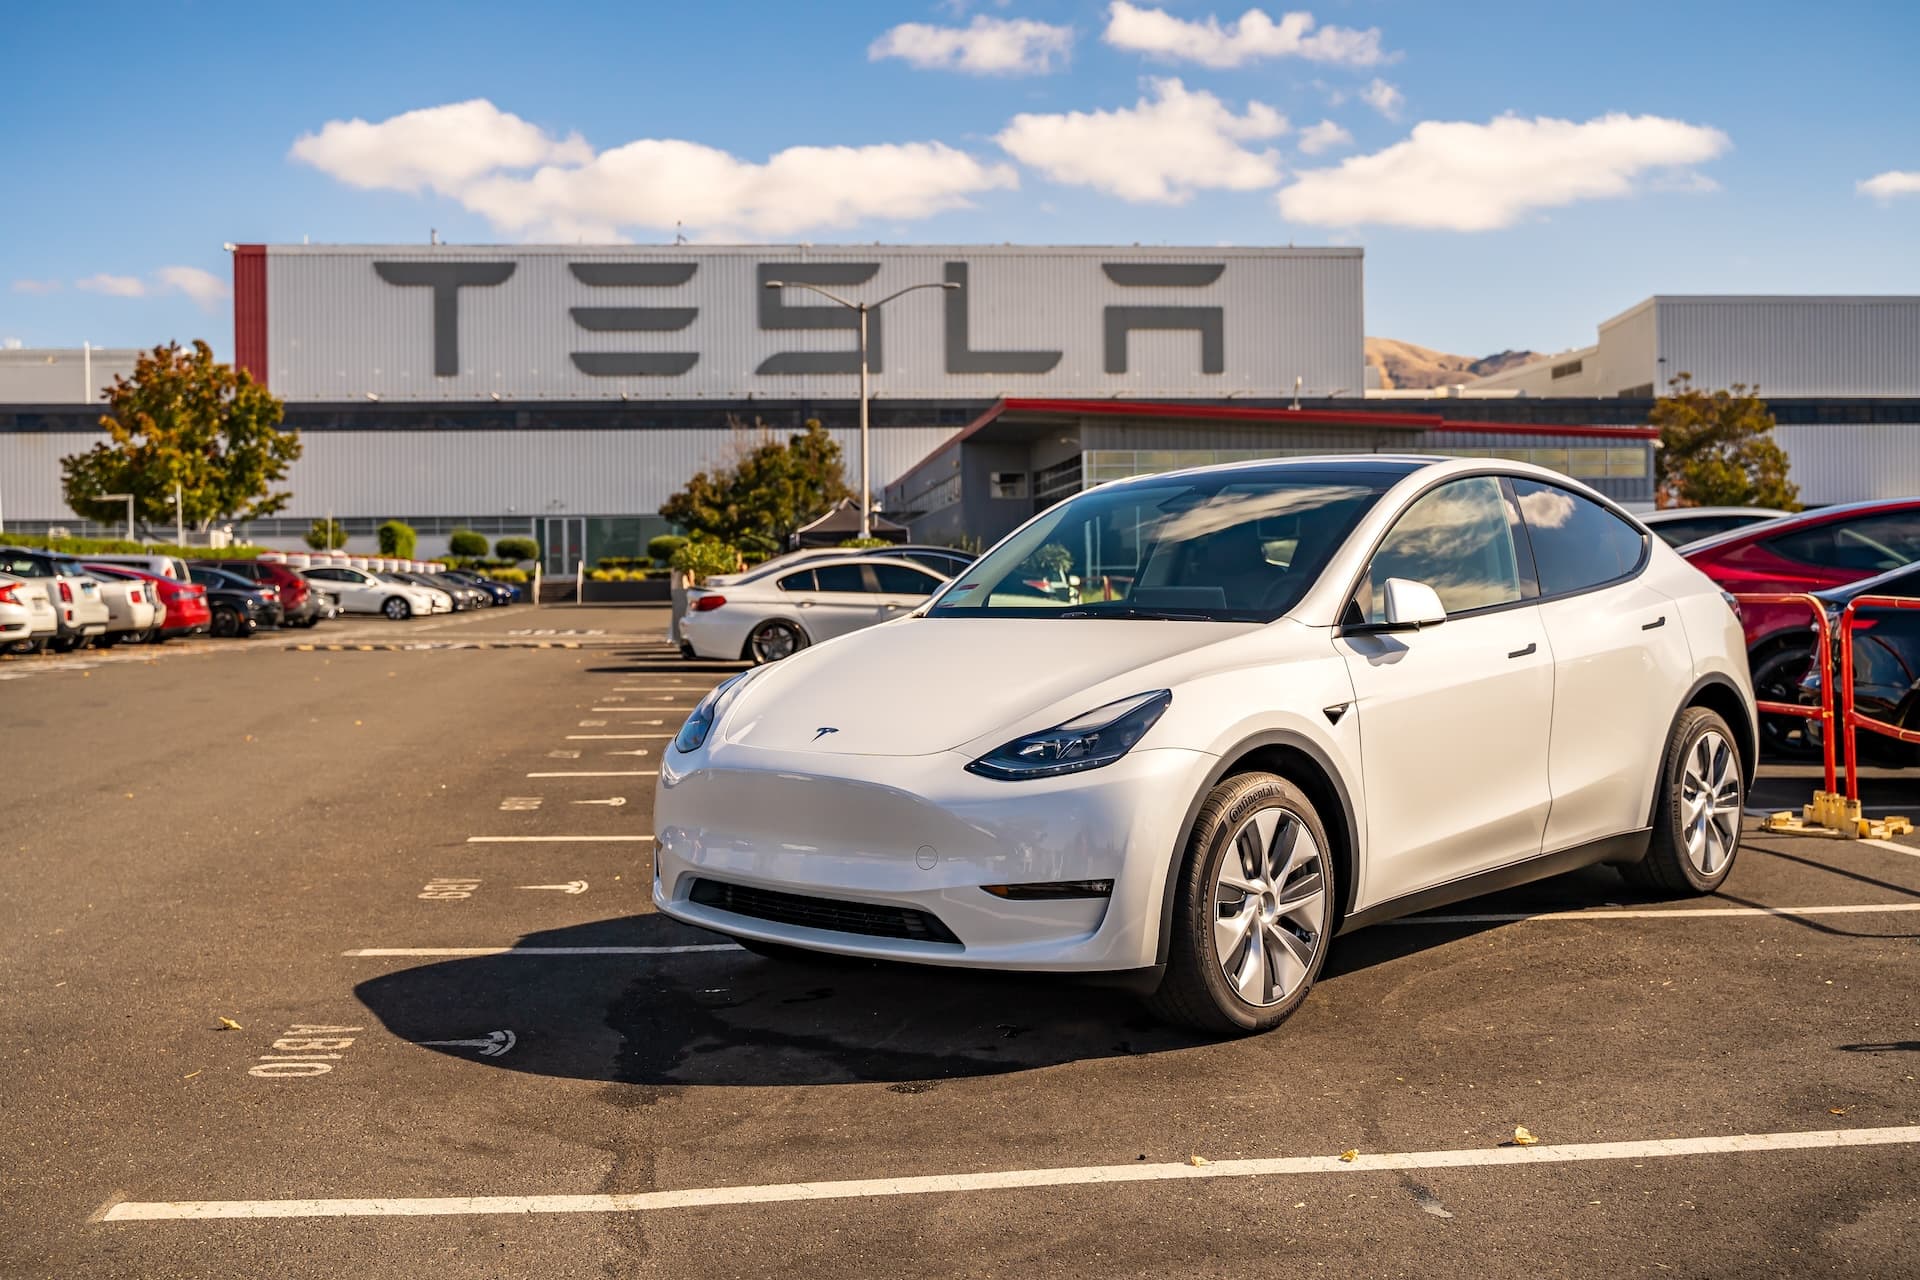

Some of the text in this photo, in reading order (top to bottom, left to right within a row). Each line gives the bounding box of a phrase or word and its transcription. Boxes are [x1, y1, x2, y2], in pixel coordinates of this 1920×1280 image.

[373, 261, 1226, 377] TESLA
[1229, 785, 1276, 823] Continental
[248, 1024, 364, 1078] AB10
